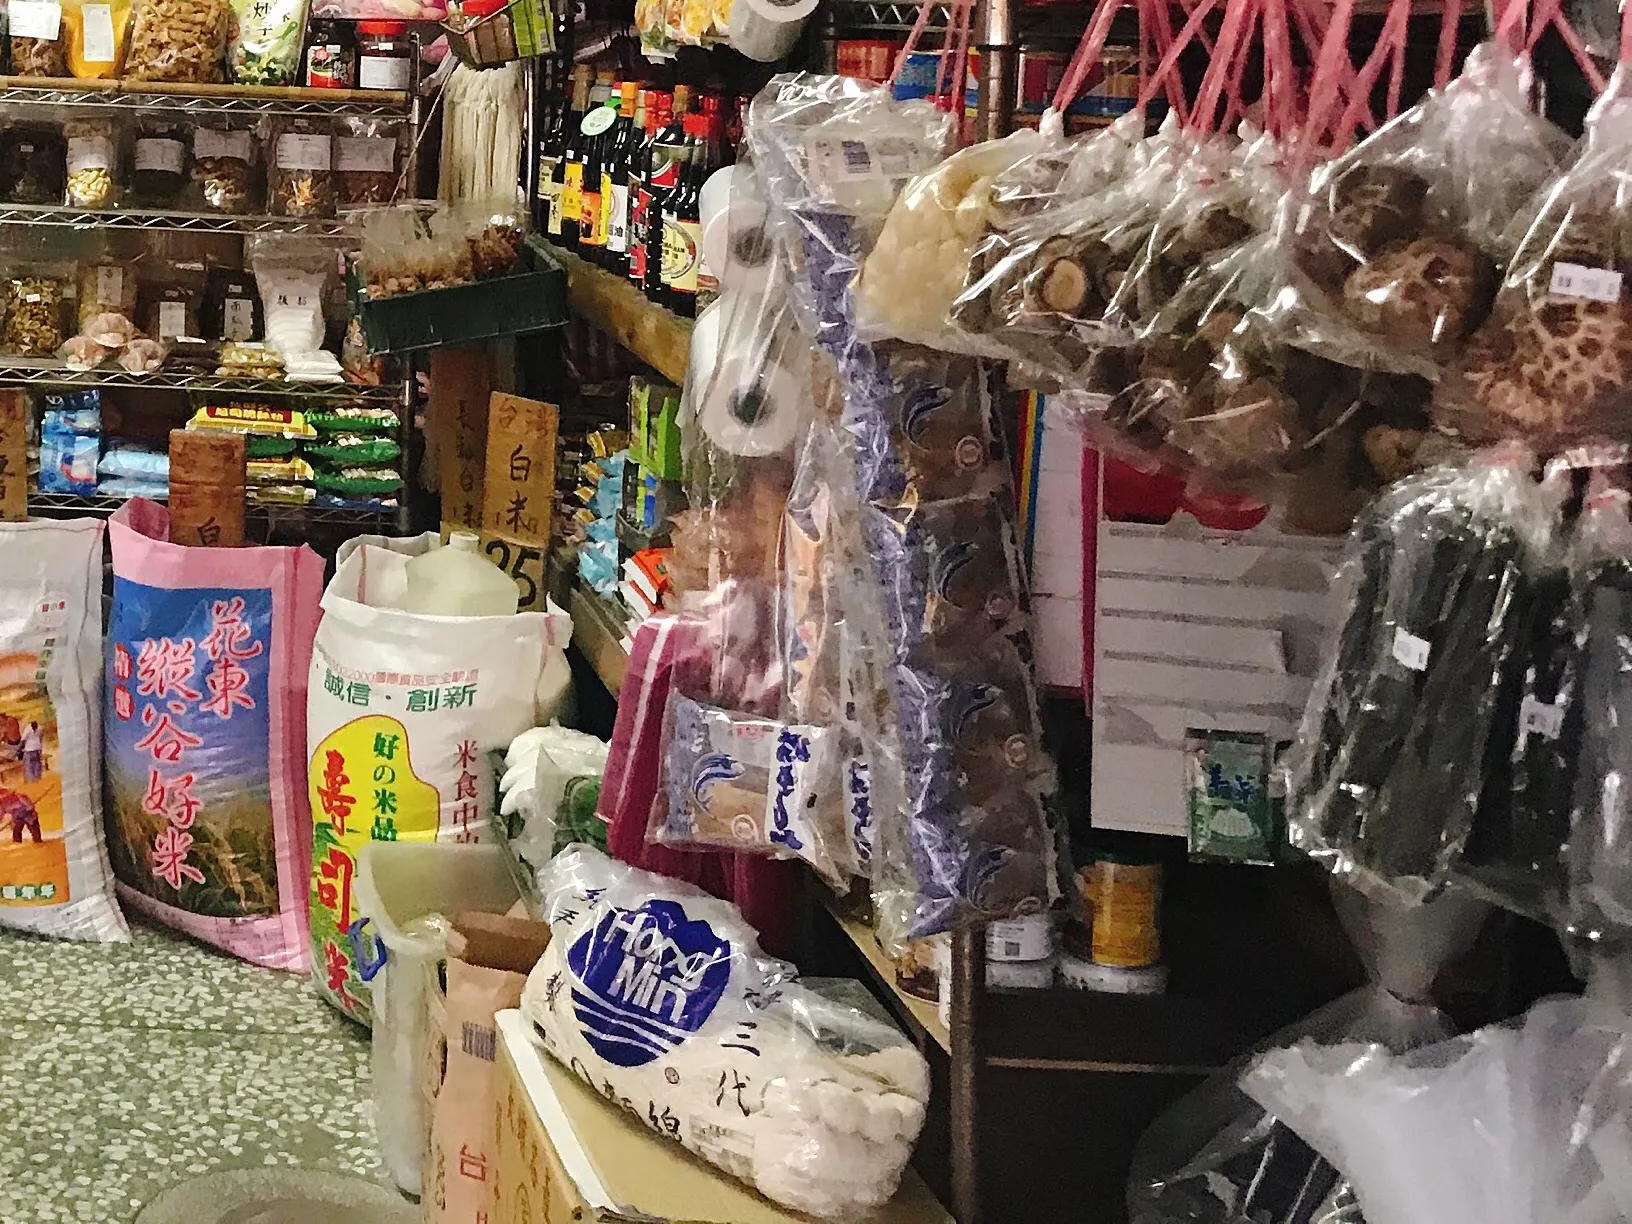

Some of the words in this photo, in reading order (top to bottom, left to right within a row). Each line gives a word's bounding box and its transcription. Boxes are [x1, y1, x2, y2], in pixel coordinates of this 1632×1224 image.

[200, 596, 263, 718] 花東
[135, 637, 206, 889] 縱谷好米
[606, 955, 688, 1025] Min
